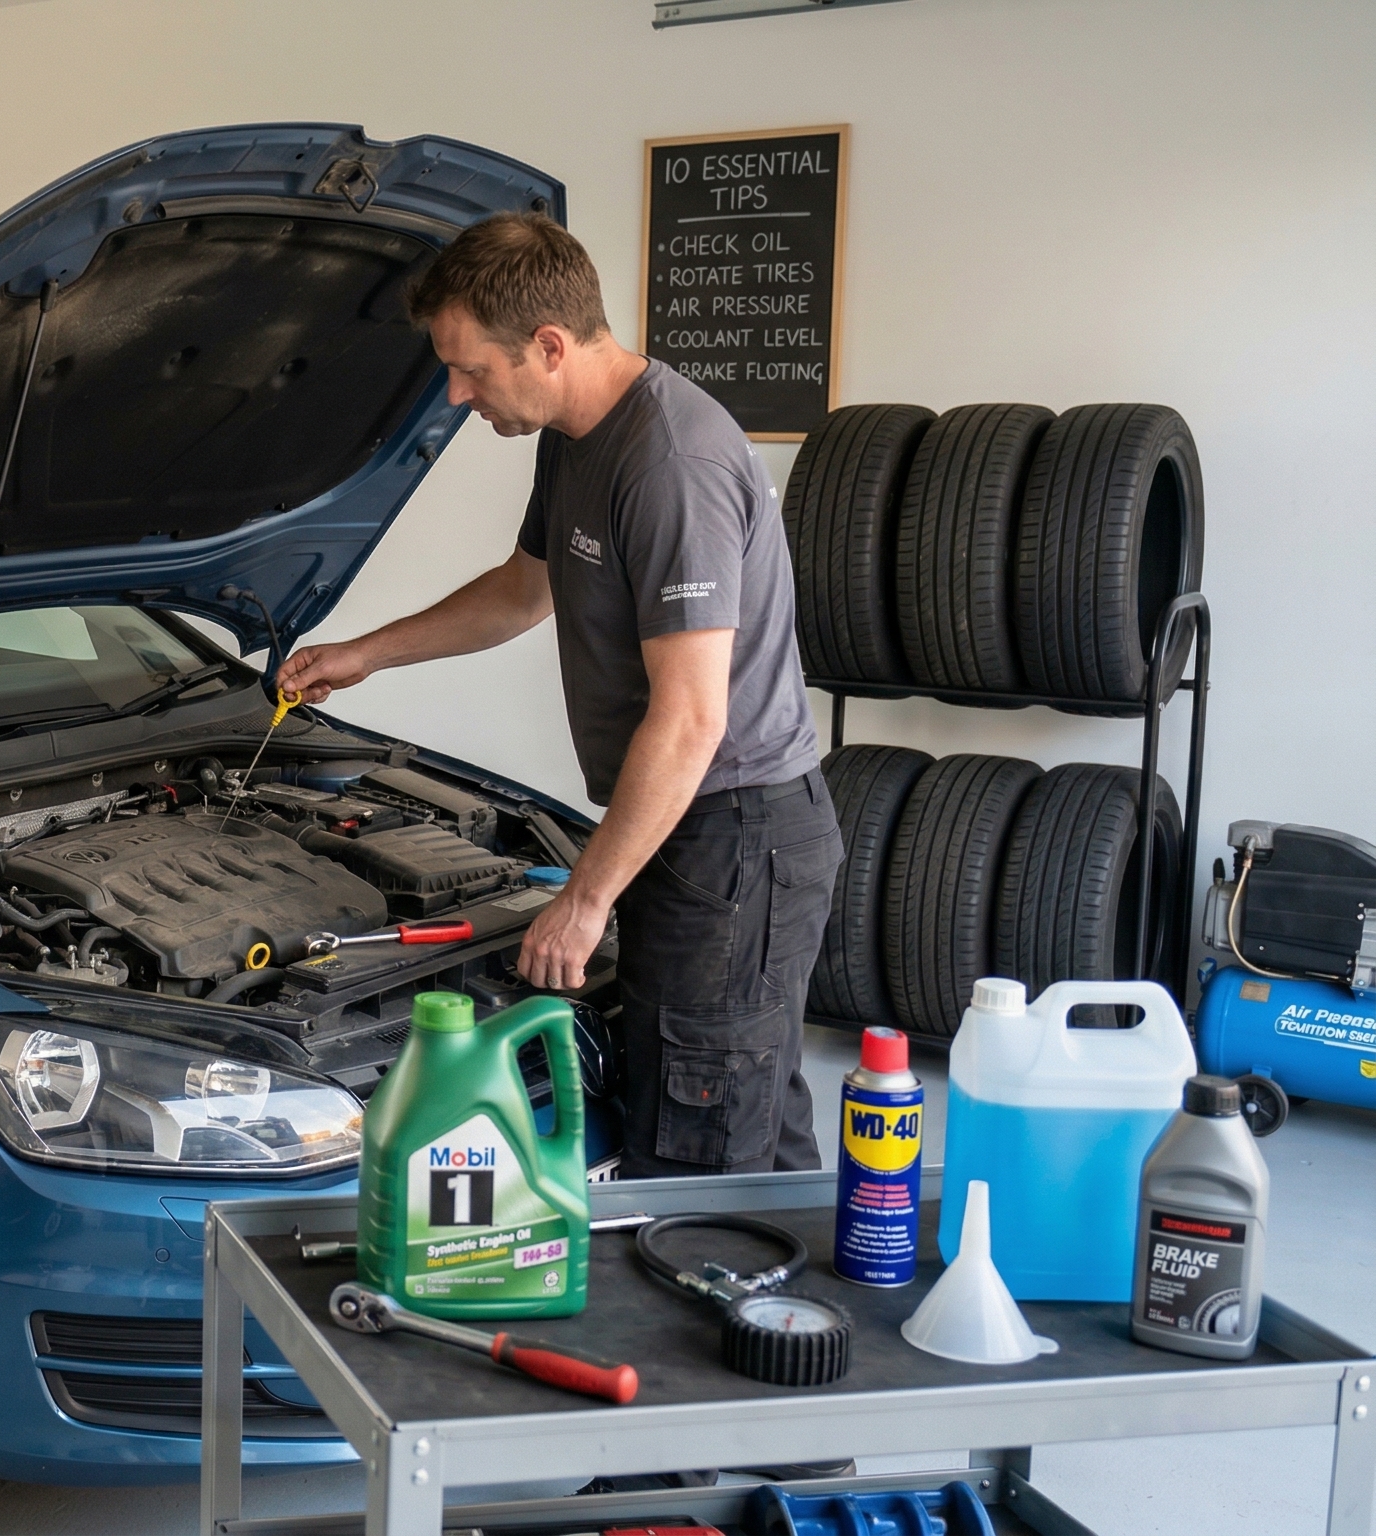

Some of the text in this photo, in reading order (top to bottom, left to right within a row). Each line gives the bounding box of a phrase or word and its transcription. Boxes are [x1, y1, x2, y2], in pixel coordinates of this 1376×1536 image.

[665, 150, 830, 184] 10 ESSENTIAL
[709, 184, 768, 211] TIPS
[669, 231, 791, 257] CHECK OIL
[669, 261, 815, 287] ROTATE TIRES
[667, 293, 811, 318] AIR PRESSURE
[666, 327, 823, 349] COOLANT LEVEL
[678, 361, 824, 386] BRAKE FLOTING
[1281, 1004, 1313, 1019] Air
[430, 1147, 495, 1167] Mobil
[447, 1174, 471, 1223] 1
[427, 1239, 477, 1258] Synthetic
[479, 1233, 515, 1249] Engine
[1153, 1243, 1220, 1269] BRAKE
[1151, 1259, 1201, 1279] FLUID
